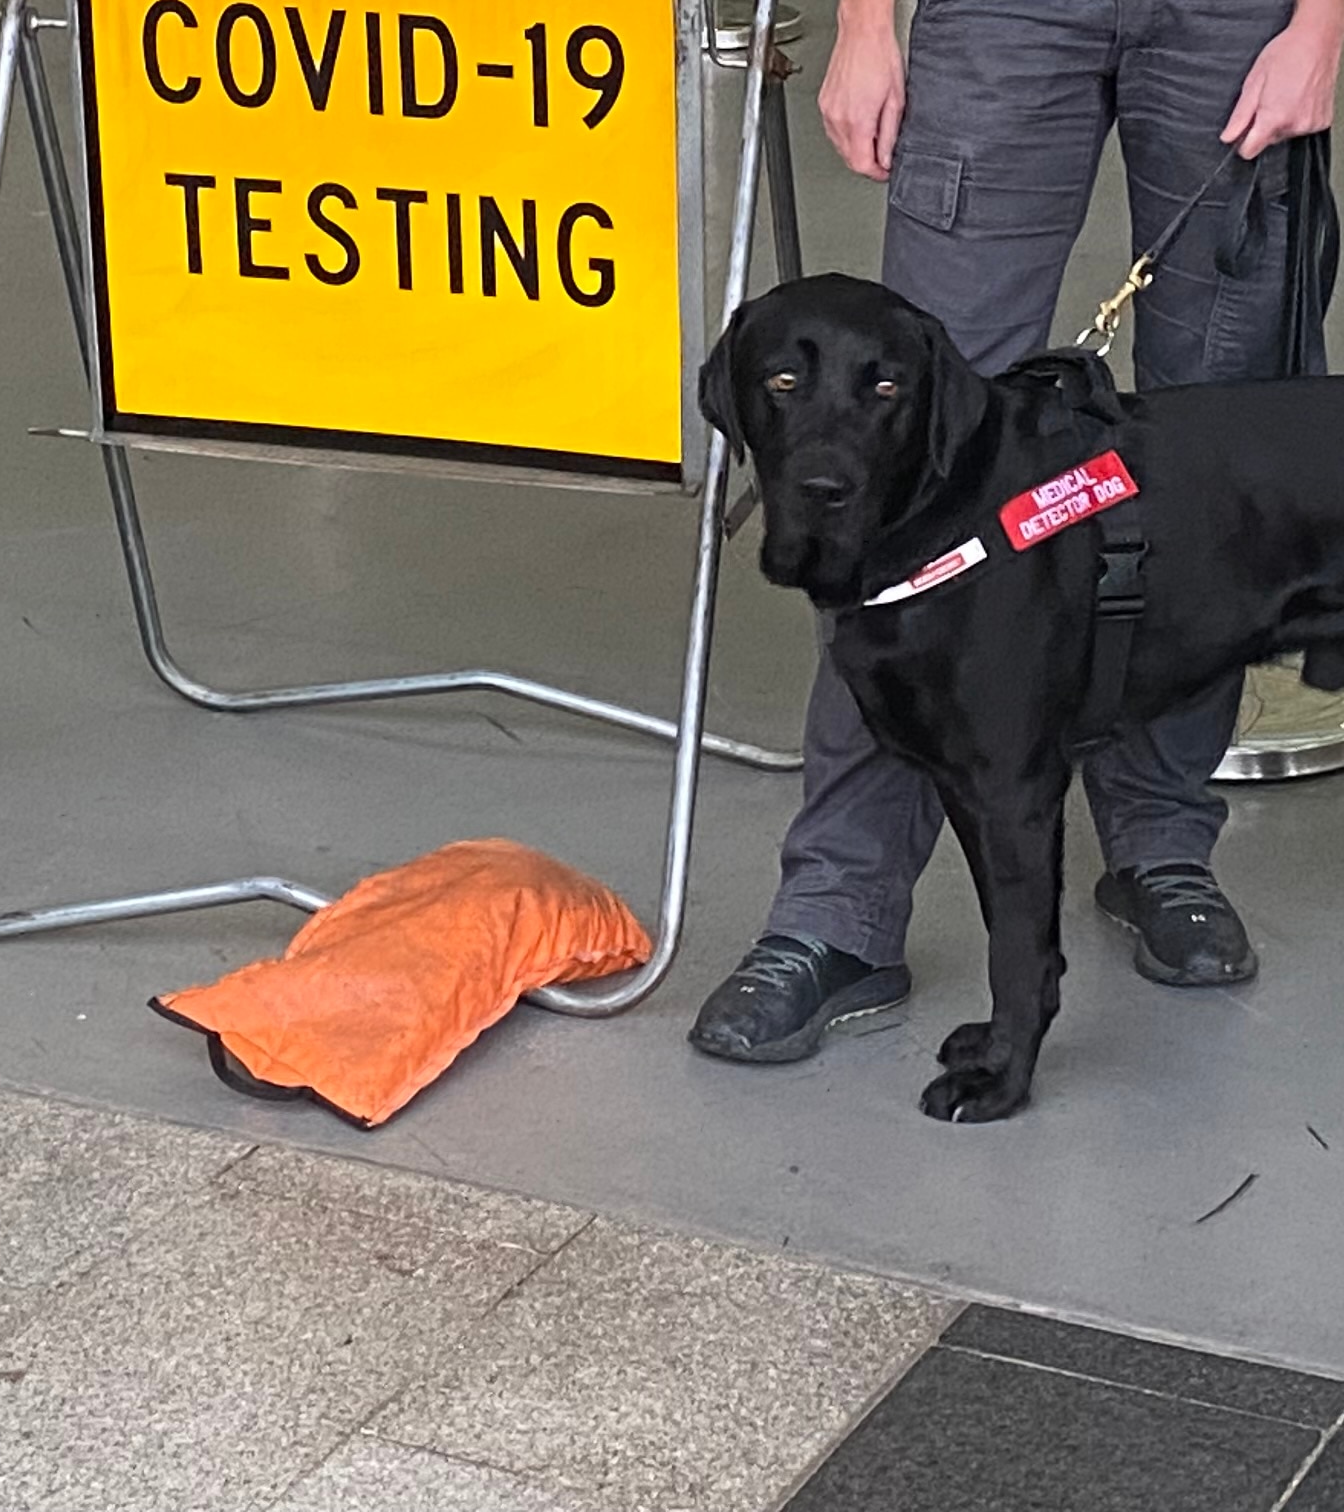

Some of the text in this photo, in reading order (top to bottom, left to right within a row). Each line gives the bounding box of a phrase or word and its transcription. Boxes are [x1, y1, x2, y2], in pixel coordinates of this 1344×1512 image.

[164, 173, 616, 309] TESTING
[1019, 476, 1125, 541] DETECTOR DOG
[1031, 467, 1098, 509] MEDICAL
